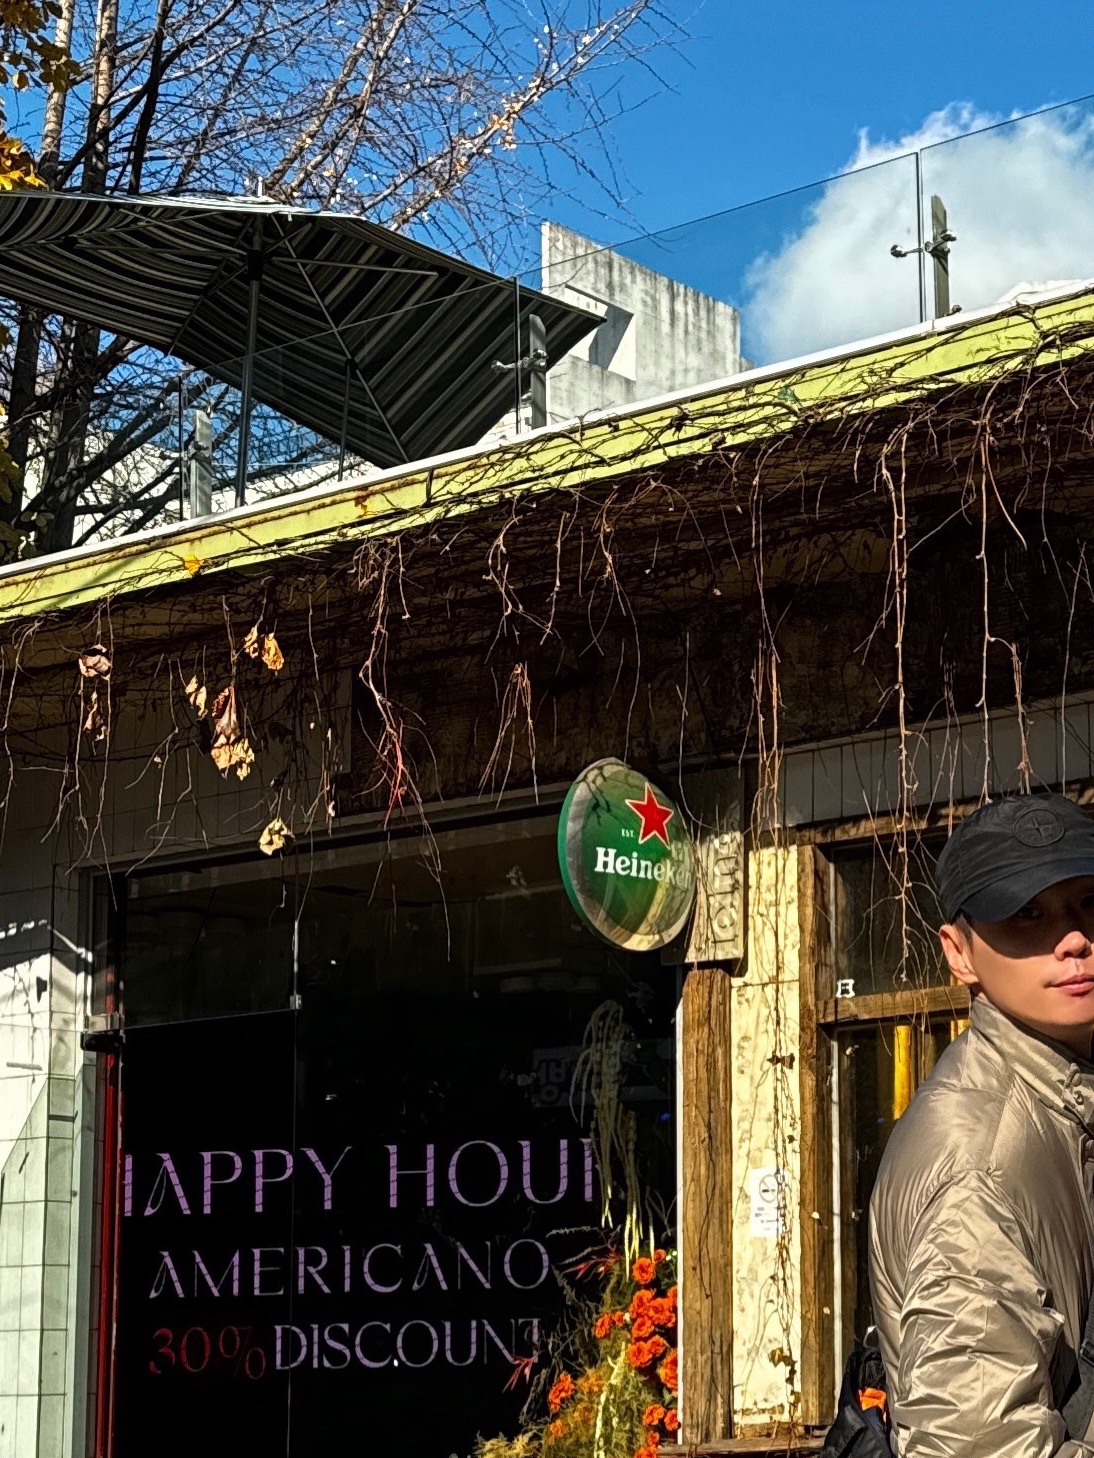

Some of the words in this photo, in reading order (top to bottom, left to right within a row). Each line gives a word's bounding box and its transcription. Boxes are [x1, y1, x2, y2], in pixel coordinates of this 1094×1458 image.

[593, 846, 692, 890] Heineken
[149, 1238, 550, 1299] AMERICANO
[149, 1325, 266, 1380] 30%
